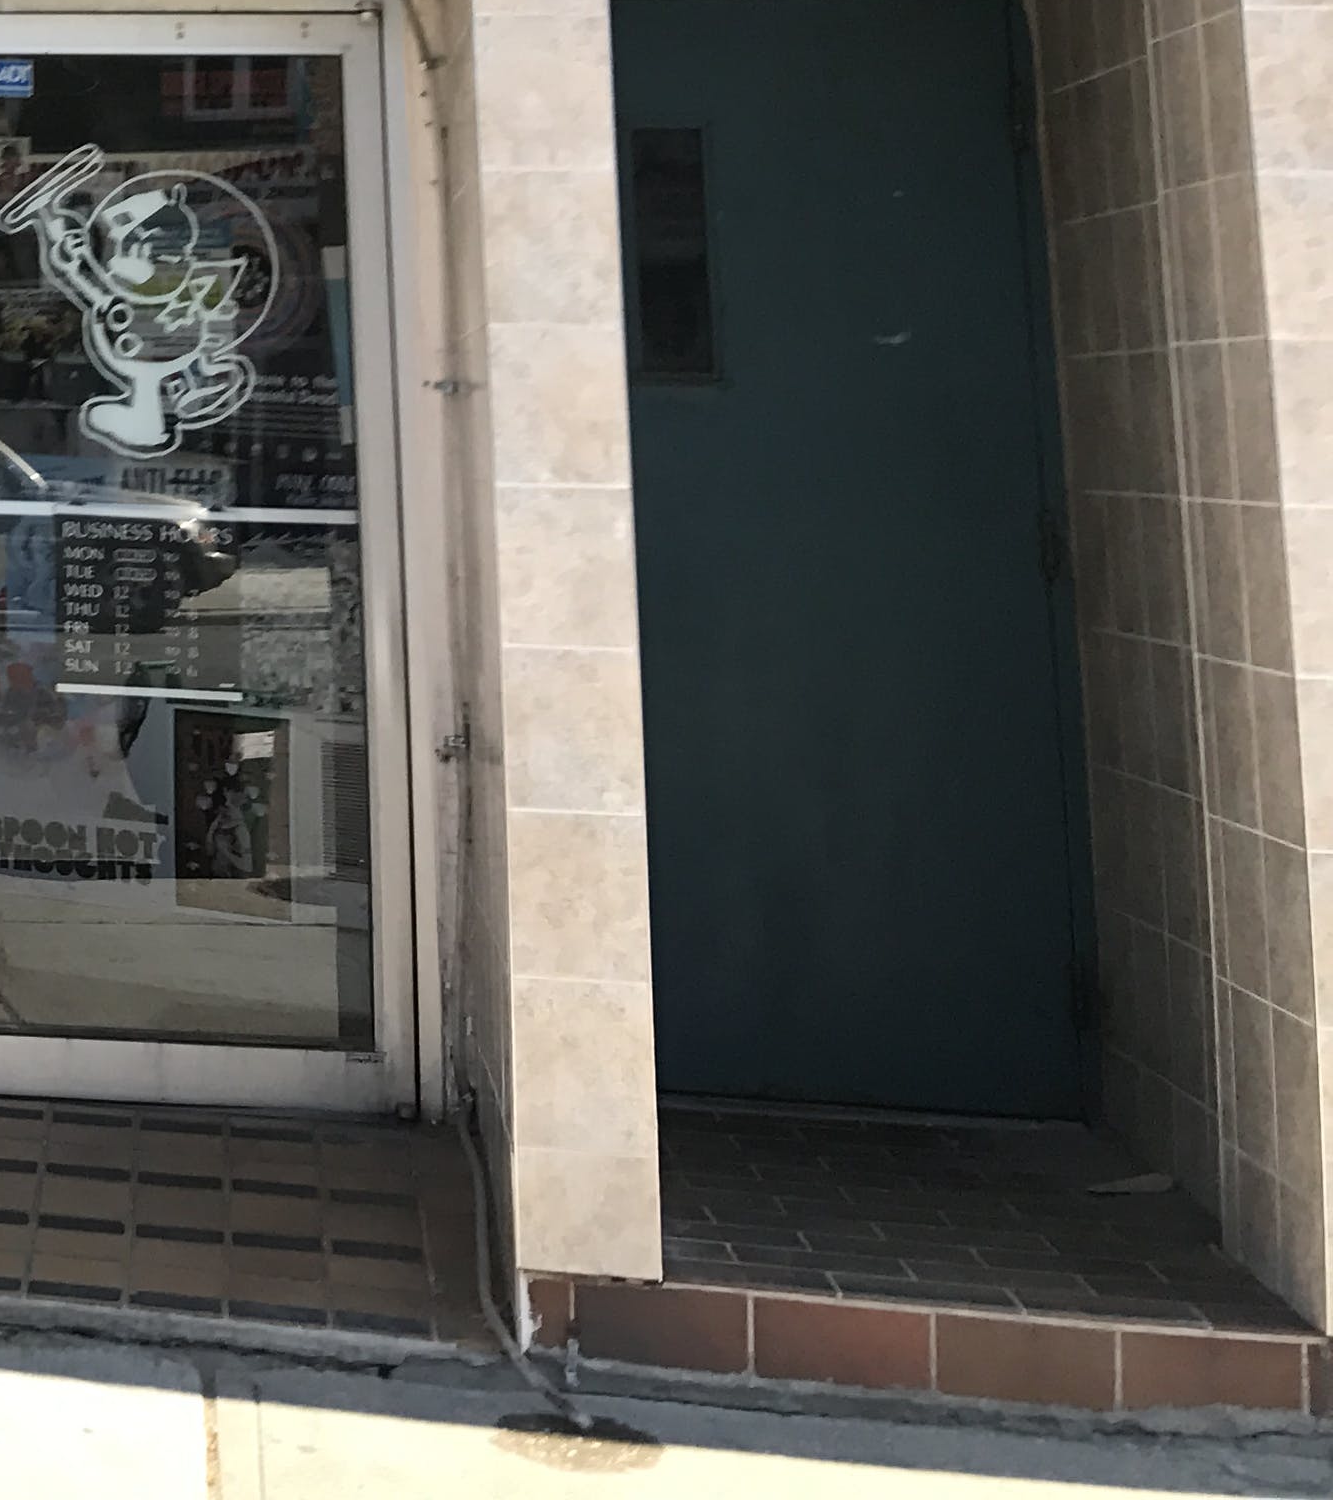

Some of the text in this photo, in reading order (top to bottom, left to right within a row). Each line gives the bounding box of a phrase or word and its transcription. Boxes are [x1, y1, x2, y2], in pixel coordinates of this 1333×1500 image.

[61, 521, 153, 542] BUSINESS
[64, 546, 104, 561] MON
[65, 565, 95, 579] TUE
[64, 583, 104, 598] WED
[65, 602, 100, 617] THU
[64, 621, 90, 635] FRI
[65, 639, 94, 654] SAT
[64, 658, 99, 673] SUN
